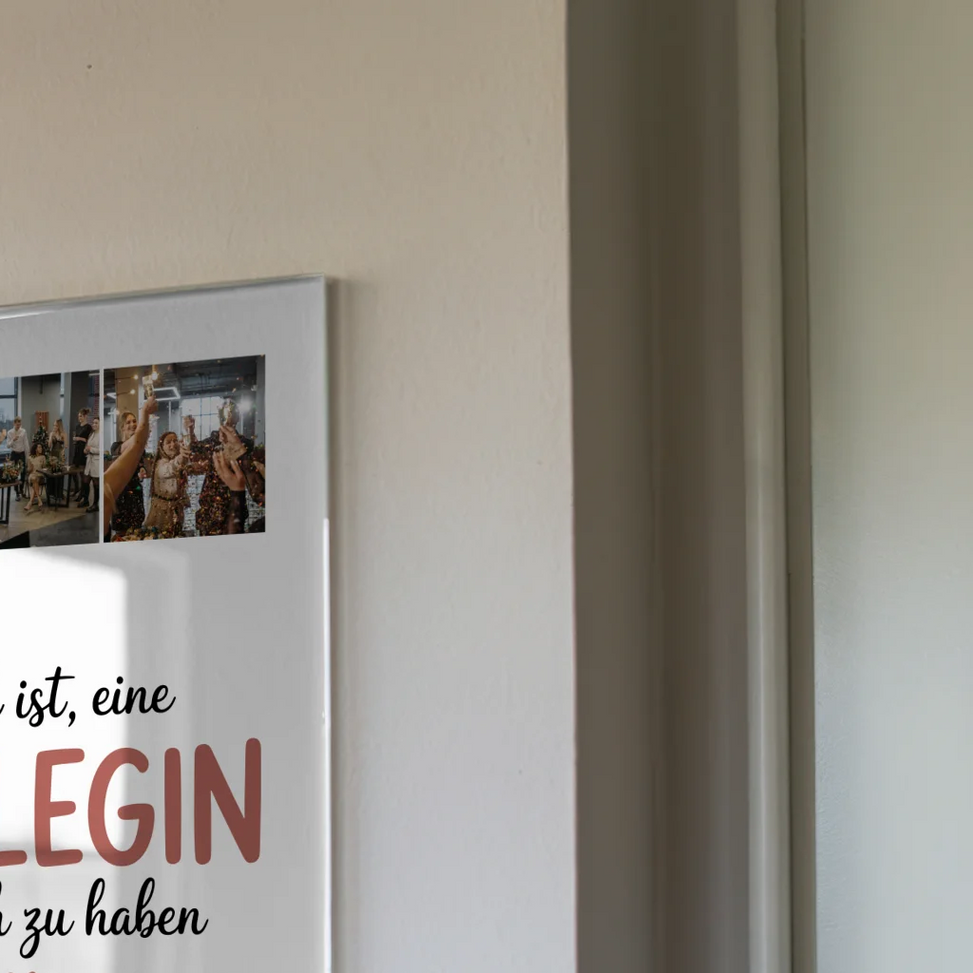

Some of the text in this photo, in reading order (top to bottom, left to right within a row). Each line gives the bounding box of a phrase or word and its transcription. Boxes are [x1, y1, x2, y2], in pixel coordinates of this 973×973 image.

[15, 666, 76, 728] ist,
[92, 676, 177, 716] eine
[19, 907, 75, 959] zu
[85, 877, 209, 939] haben
